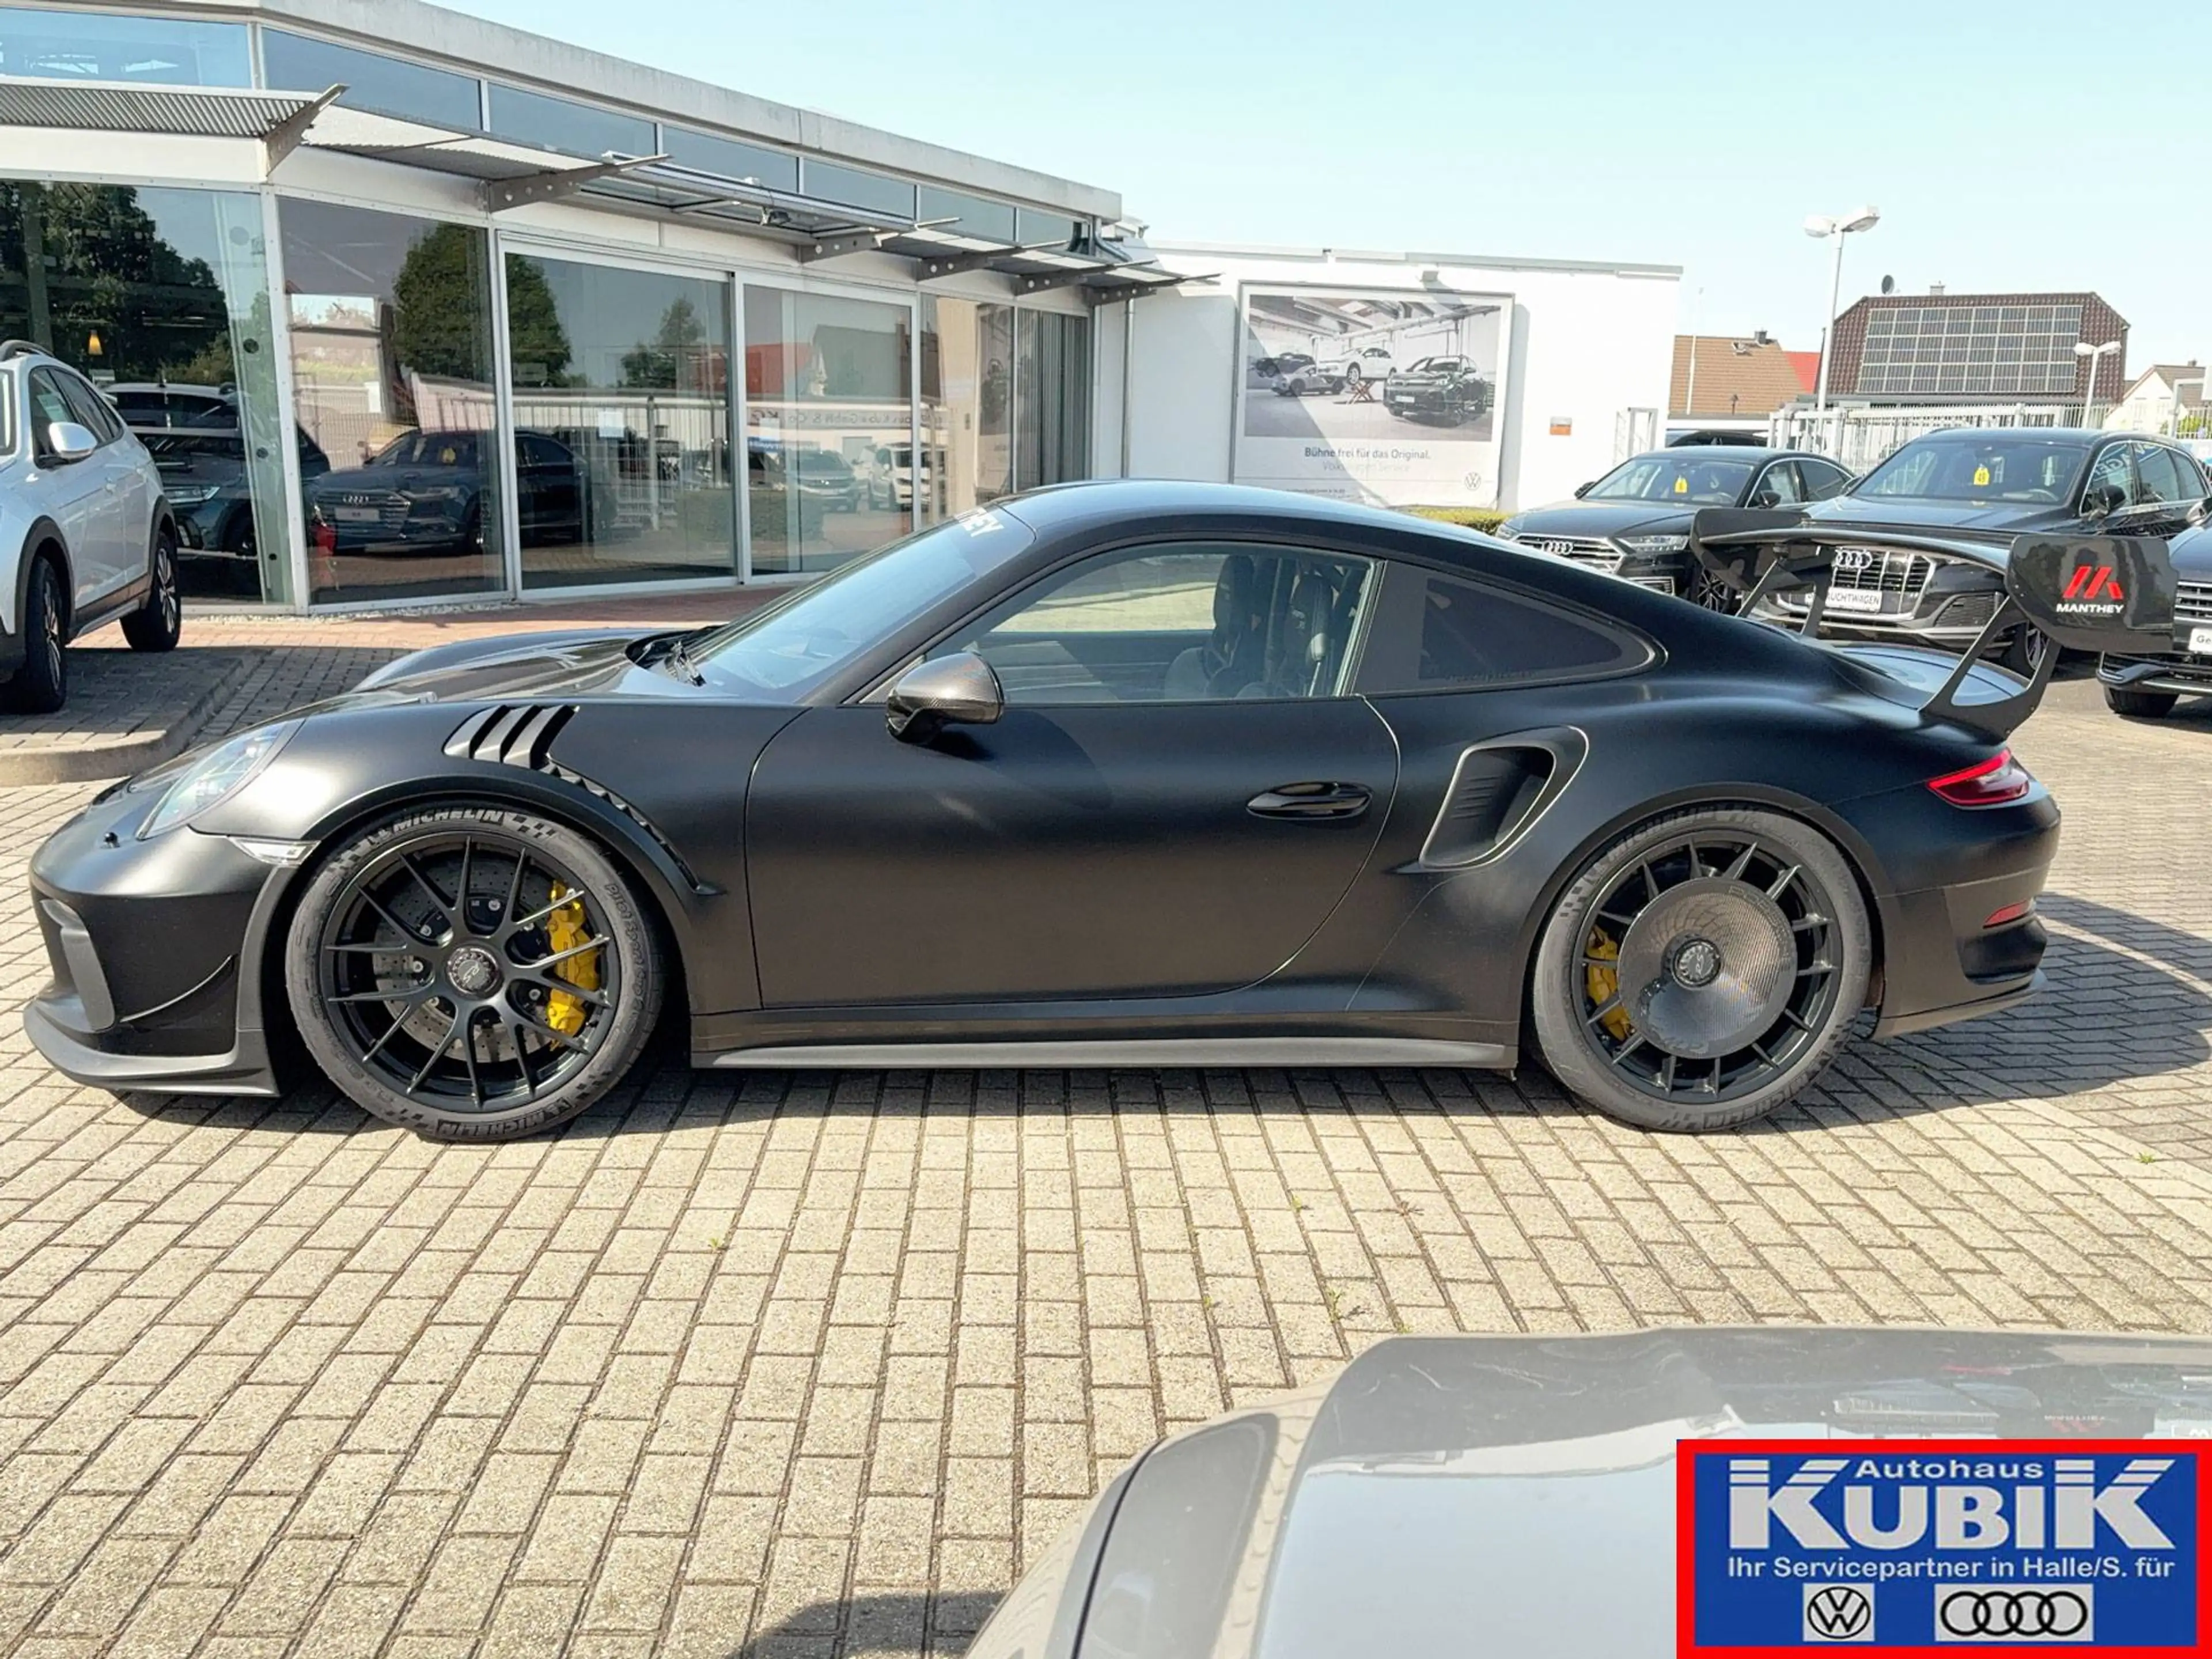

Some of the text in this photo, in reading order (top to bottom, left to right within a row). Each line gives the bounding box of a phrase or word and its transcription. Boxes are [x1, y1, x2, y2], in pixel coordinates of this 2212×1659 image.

[1304, 447, 1335, 457] Bühne
[1338, 448, 1353, 457] frei
[1356, 448, 1370, 458] für
[1372, 449, 1389, 459] das
[2056, 603, 2125, 614] MANTHEY
[392, 810, 505, 834] MICHELIN
[605, 883, 633, 917] Pilot
[463, 961, 480, 987] RS
